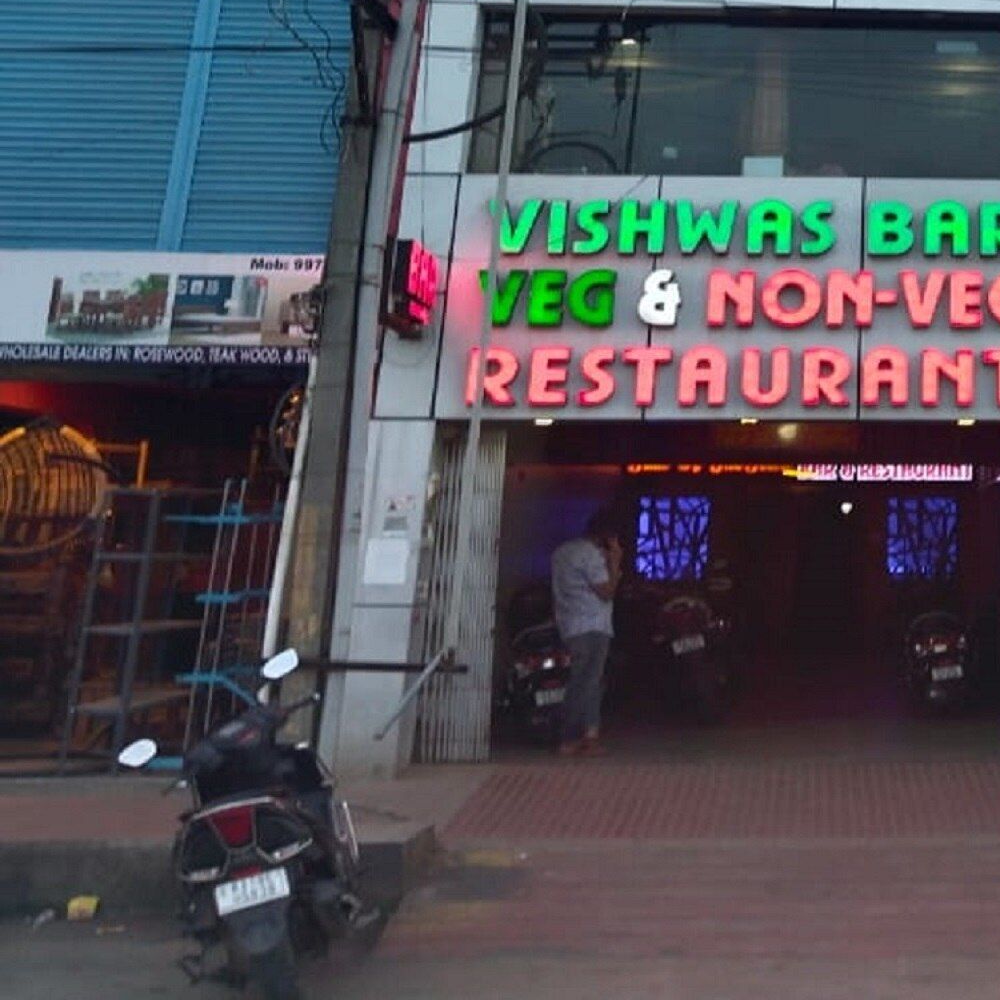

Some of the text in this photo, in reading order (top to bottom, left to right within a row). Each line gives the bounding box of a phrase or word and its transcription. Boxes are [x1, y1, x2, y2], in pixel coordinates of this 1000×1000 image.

[488, 199, 838, 255] VISHWAS
[478, 268, 617, 327] VEG
[638, 269, 681, 327] &
